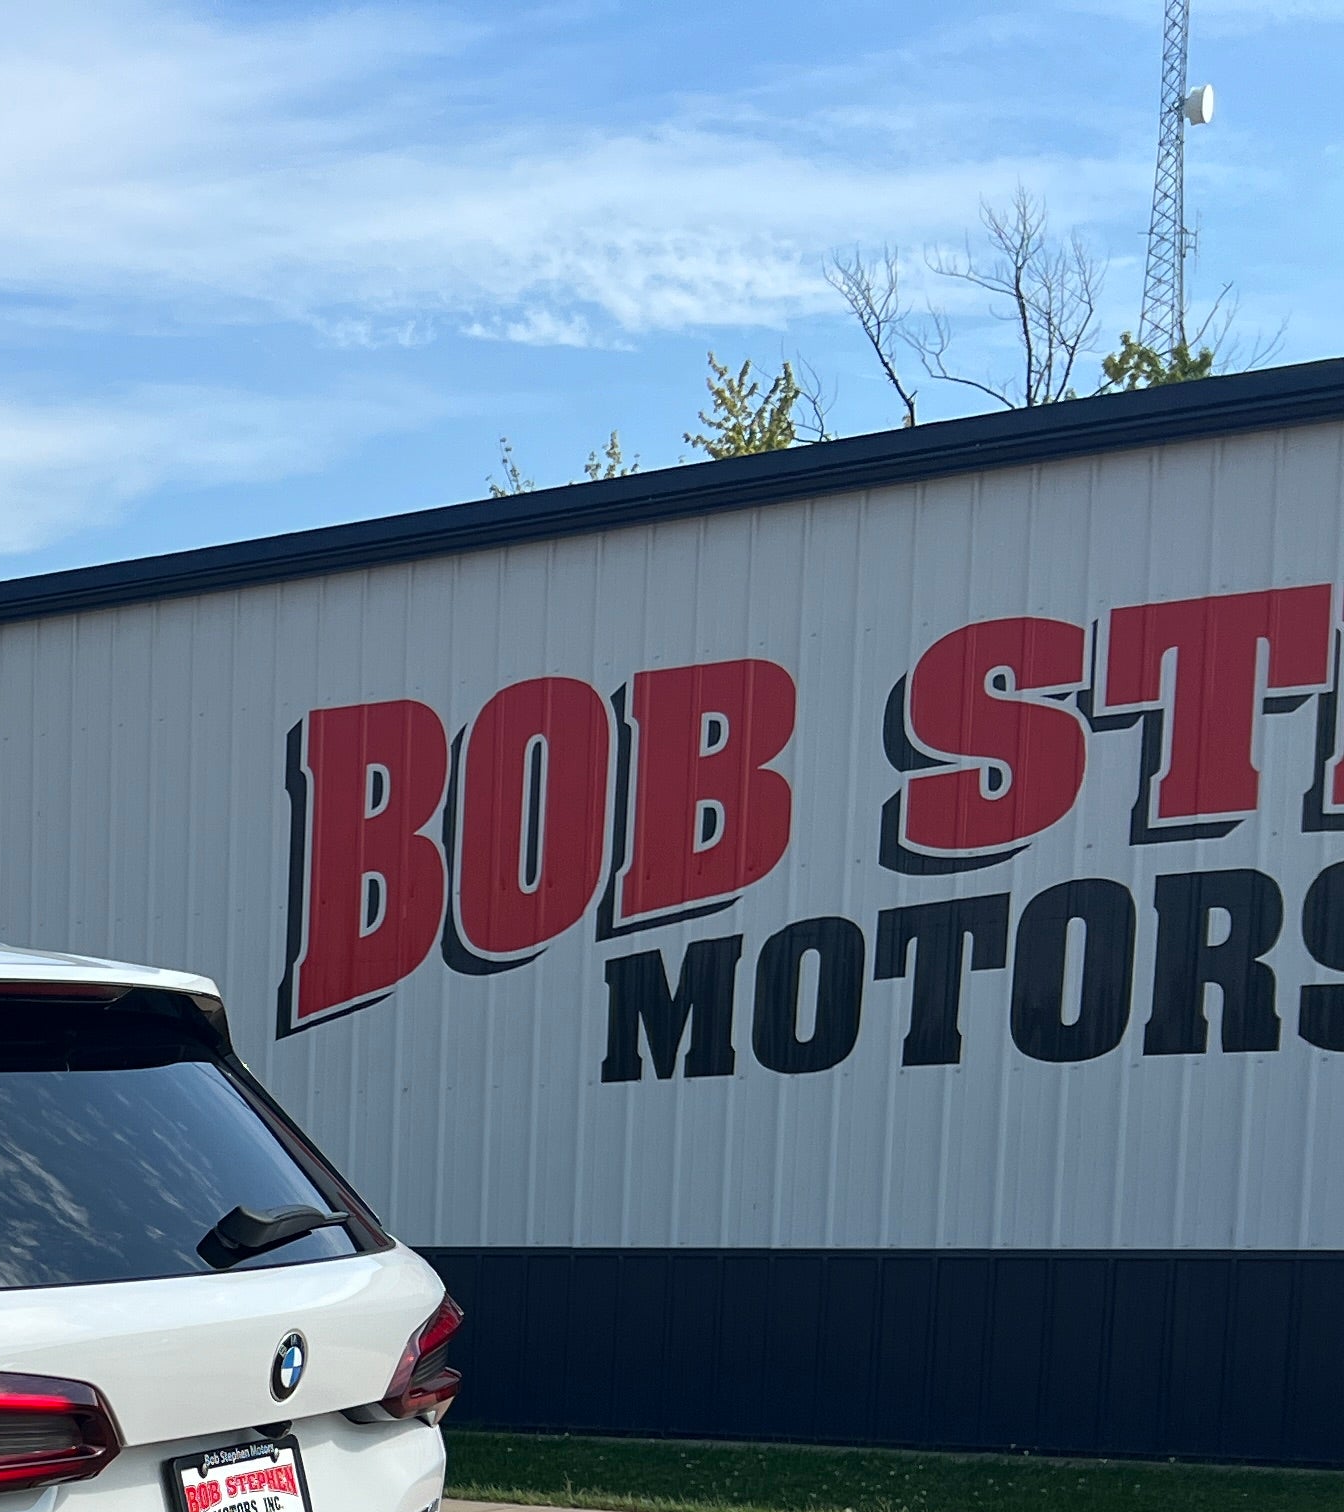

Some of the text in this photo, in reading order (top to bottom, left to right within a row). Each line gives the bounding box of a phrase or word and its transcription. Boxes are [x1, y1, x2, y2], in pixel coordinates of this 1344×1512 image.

[277, 578, 1344, 1040] BOB ST
[204, 1443, 274, 1466] Bob Stephen Motors
[225, 1463, 298, 1498] STEPHEN
